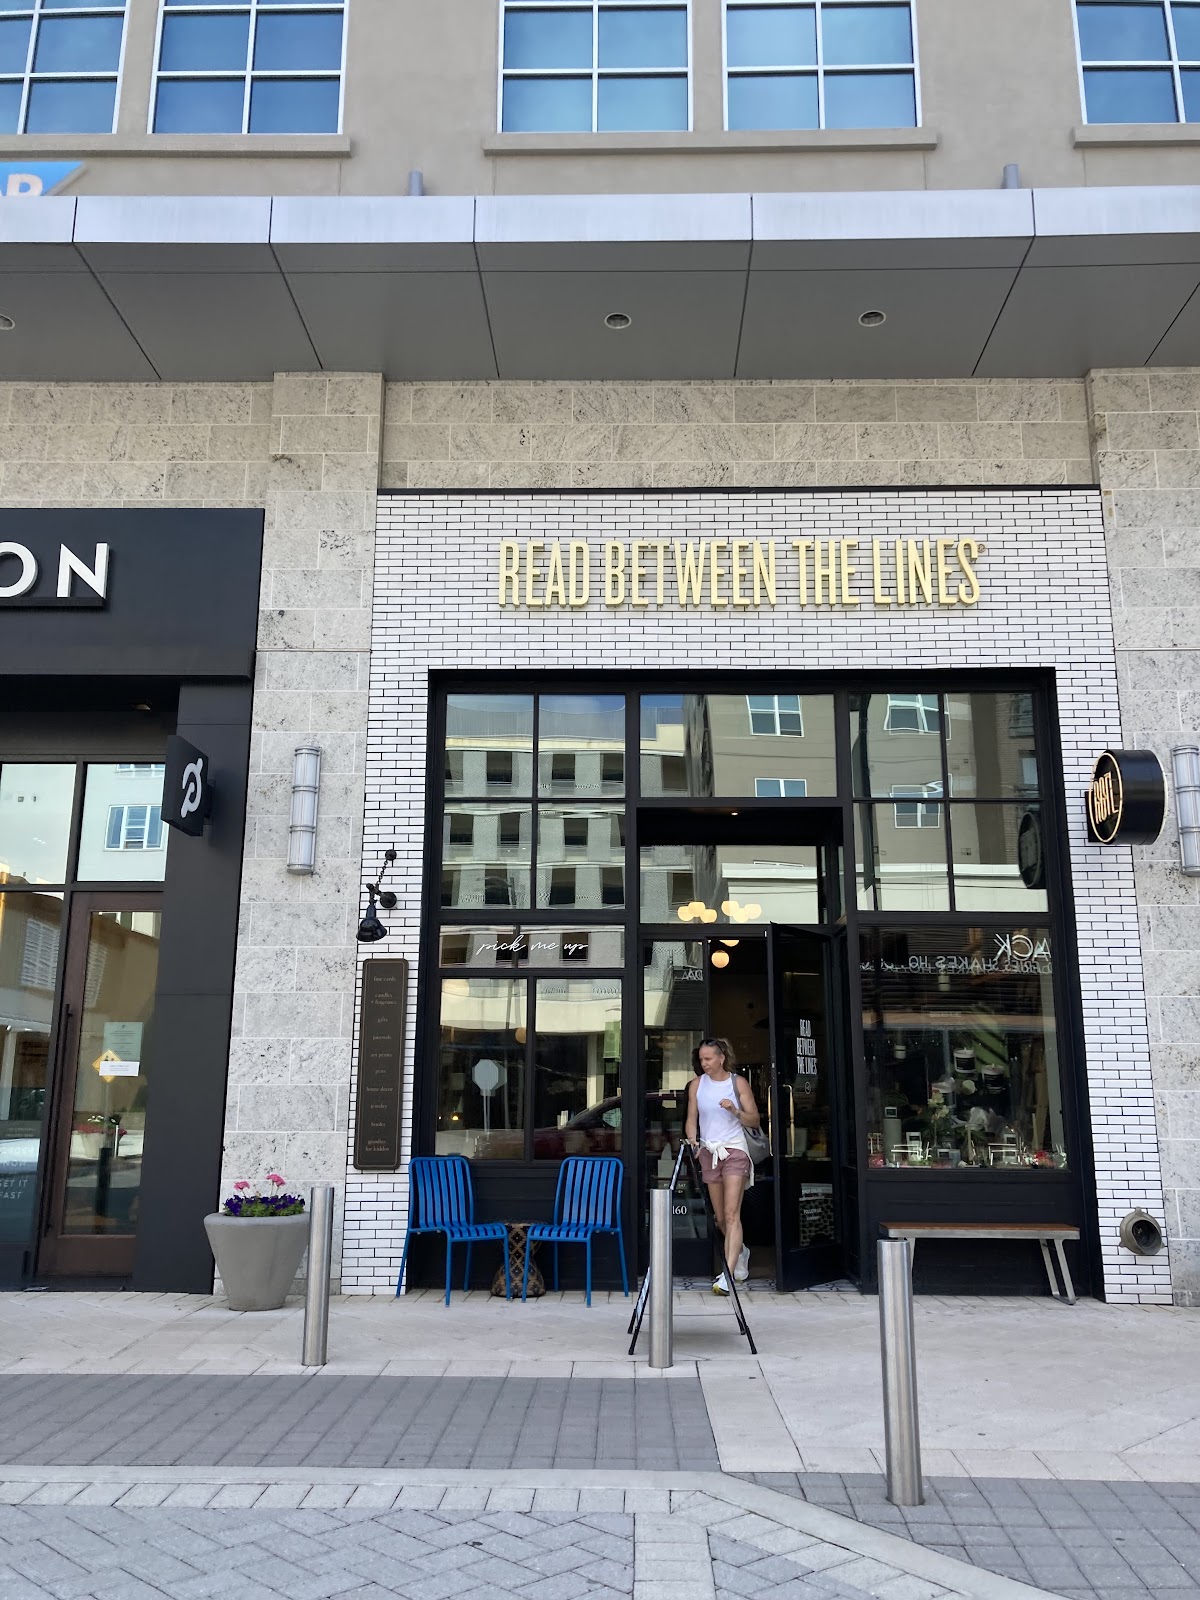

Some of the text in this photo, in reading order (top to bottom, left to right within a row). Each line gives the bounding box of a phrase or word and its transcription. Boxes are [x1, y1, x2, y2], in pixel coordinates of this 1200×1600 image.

[498, 540, 590, 607] READ
[604, 540, 776, 607] BETWEEN
[792, 539, 858, 606] THE
[476, 934, 589, 956] pick me up
[370, 1102, 388, 1110] jewelry
